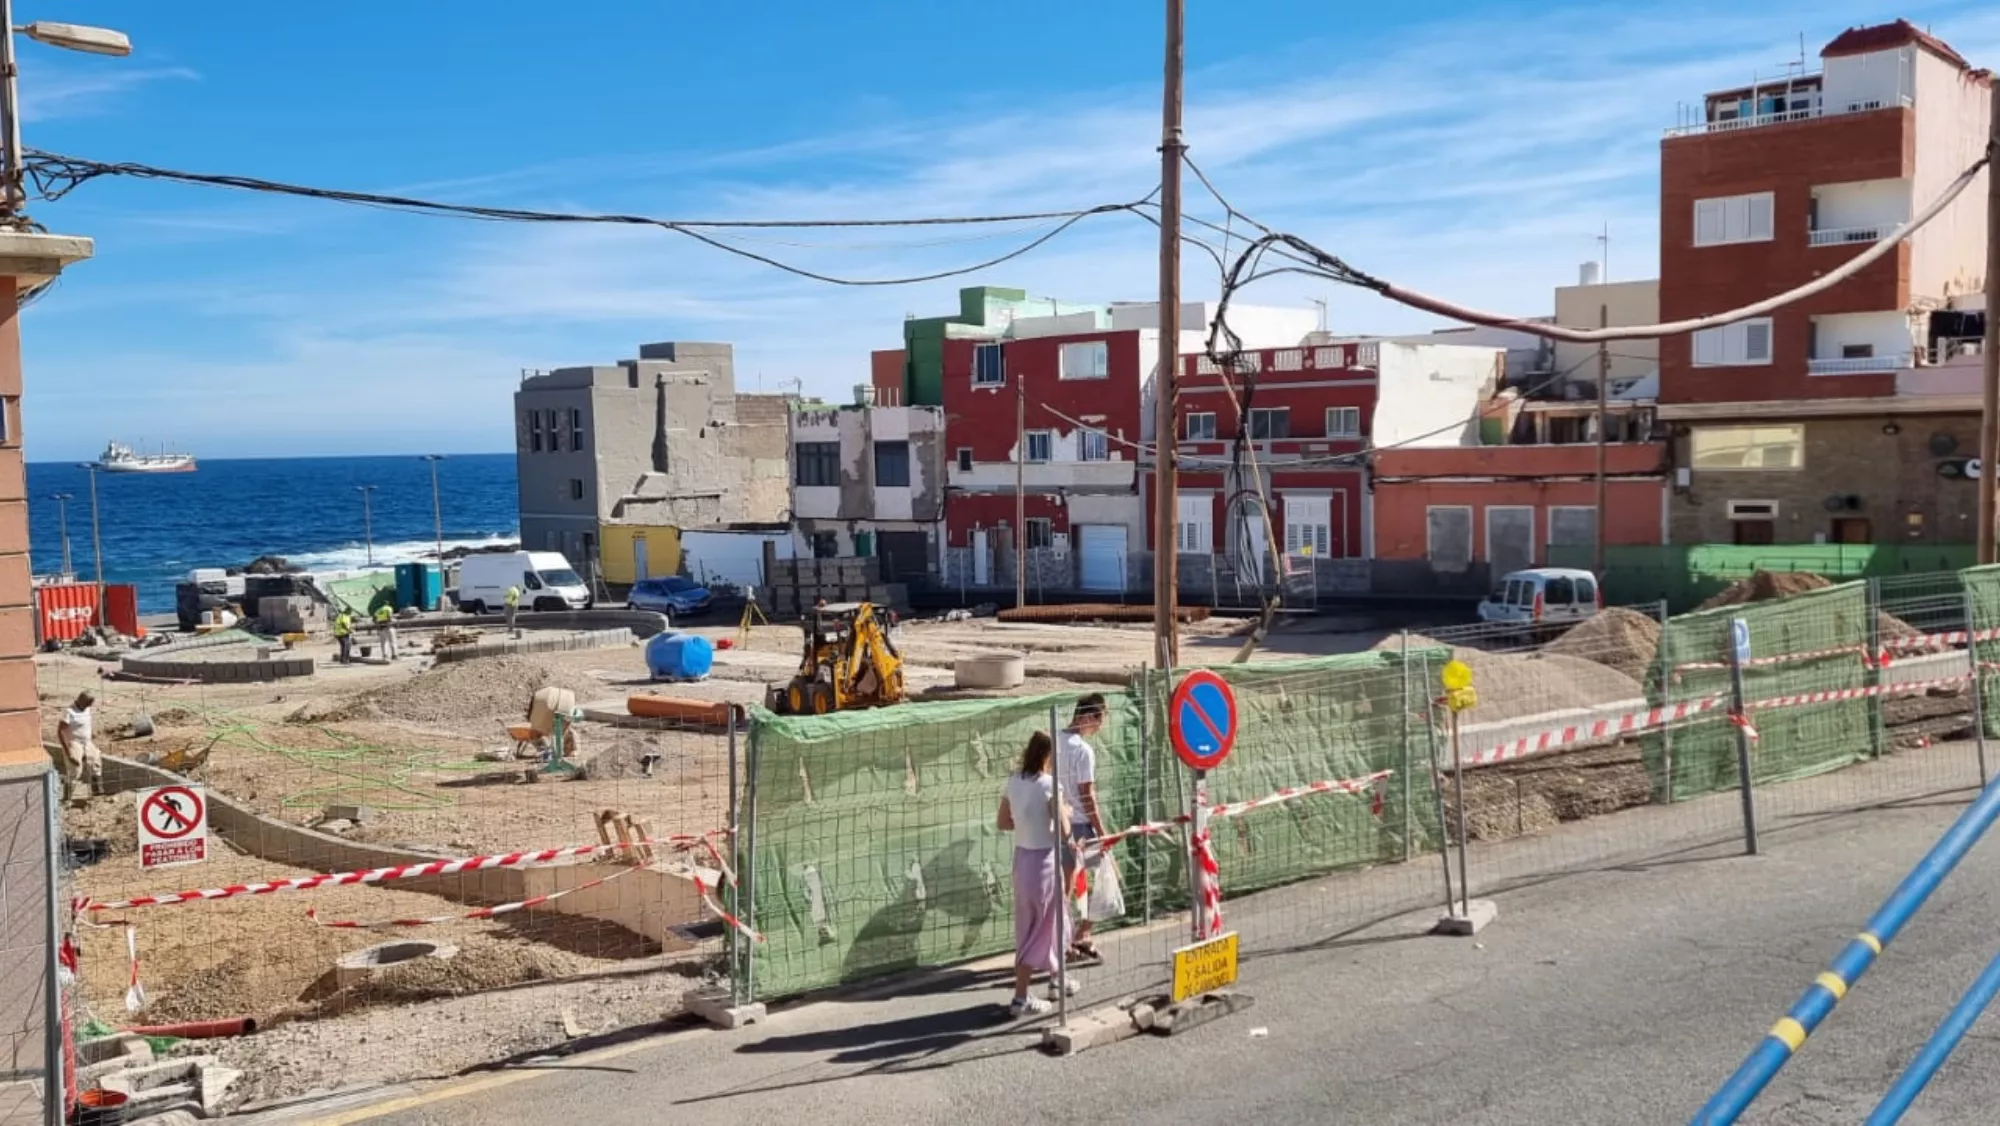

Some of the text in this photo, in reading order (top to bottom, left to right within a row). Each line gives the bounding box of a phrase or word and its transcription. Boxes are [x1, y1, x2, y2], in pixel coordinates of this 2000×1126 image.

[1185, 938, 1230, 964] ENTRADA
[1185, 956, 1228, 982] Y SALIDA
